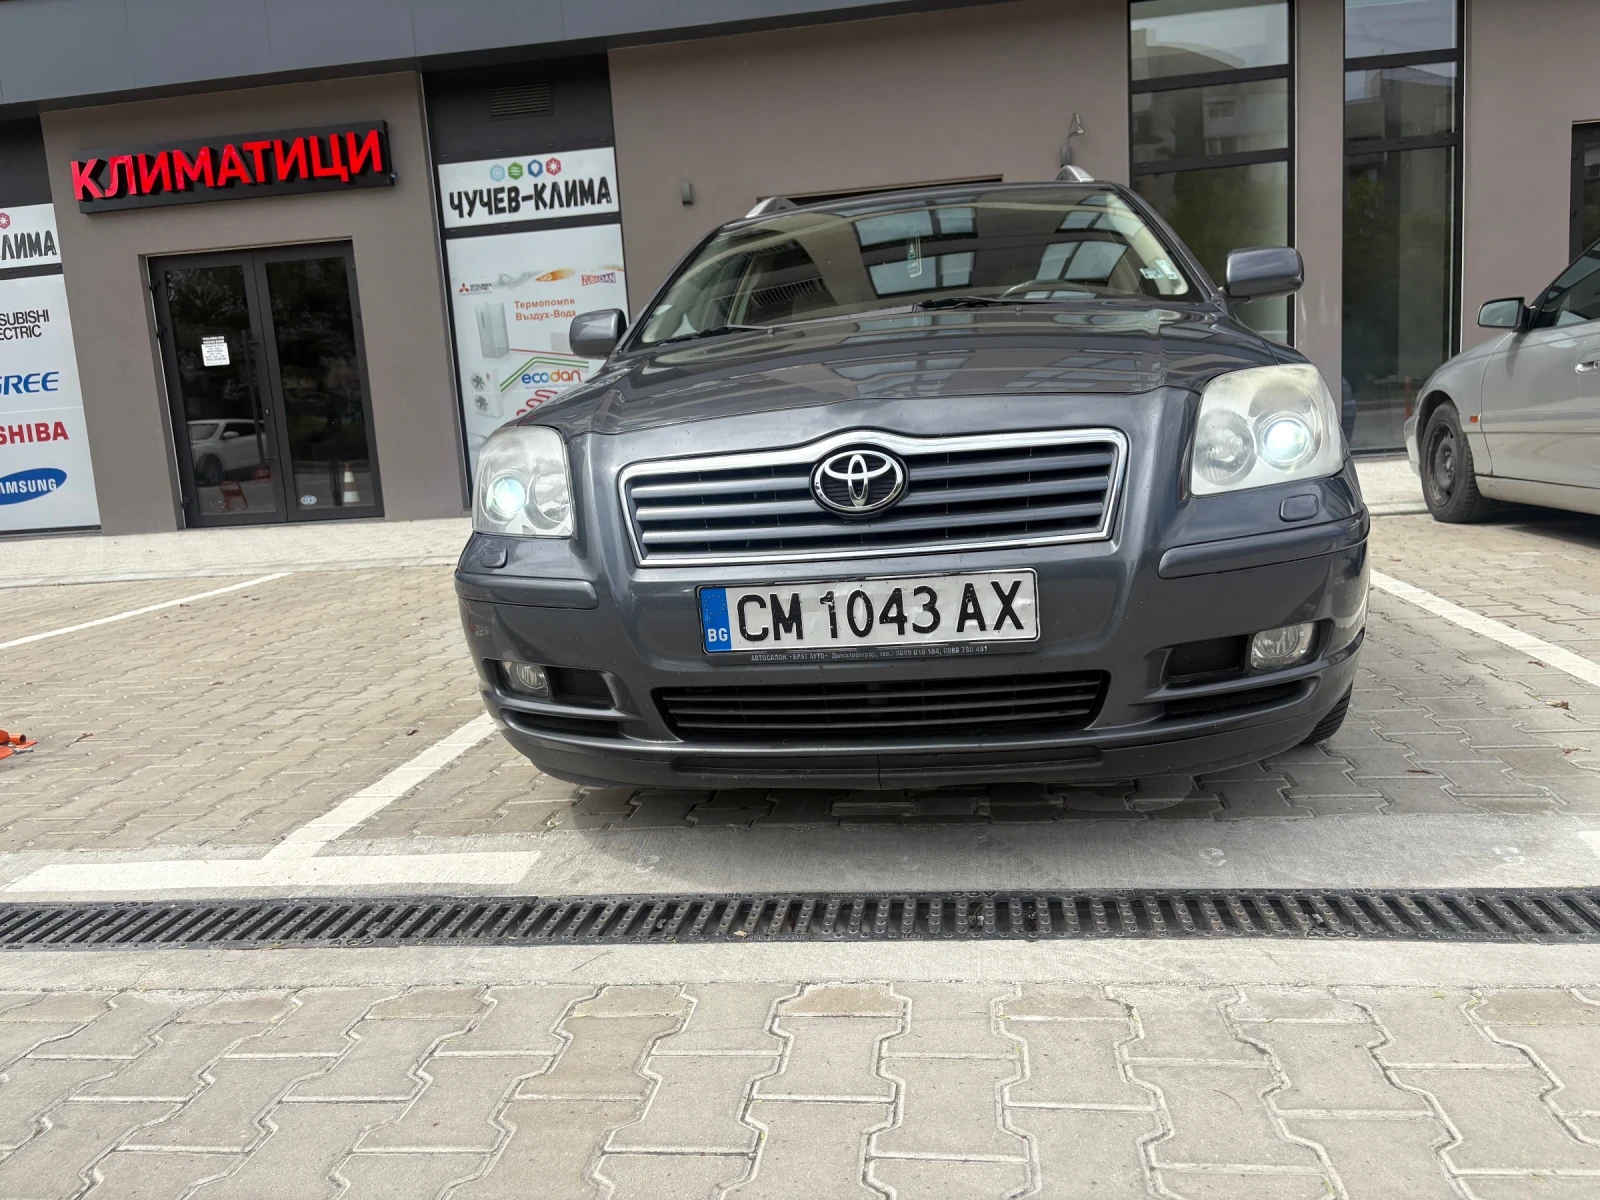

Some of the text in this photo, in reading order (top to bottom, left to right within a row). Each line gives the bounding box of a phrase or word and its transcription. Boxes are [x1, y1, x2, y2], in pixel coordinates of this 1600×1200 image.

[70, 129, 383, 201] КЛИМАТИЦИ
[448, 176, 612, 219] ЧУЧЕВ-КЛИМА
[0, 229, 58, 261] ЛИМА
[514, 297, 576, 310] Термопомпи
[515, 309, 577, 321] Въздух-Вода
[0, 371, 59, 396] REE
[521, 369, 582, 385] ecodan
[736, 580, 1025, 642] CM 1043 AX
[707, 627, 729, 643] BG
